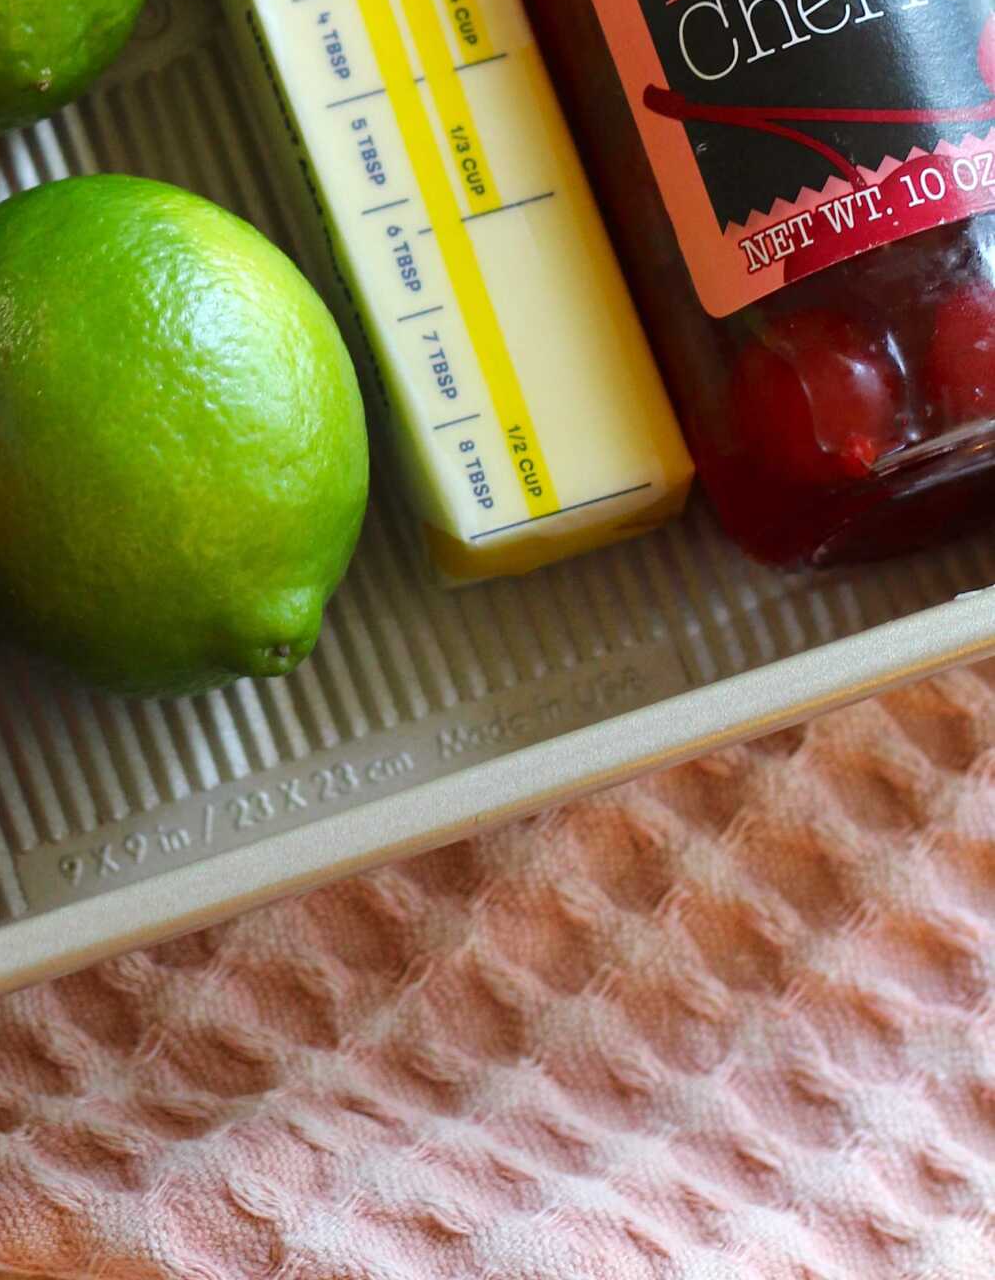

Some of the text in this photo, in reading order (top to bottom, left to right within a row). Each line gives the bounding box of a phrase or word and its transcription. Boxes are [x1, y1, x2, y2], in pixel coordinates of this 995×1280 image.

[317, 10, 351, 80] 4 TBSP
[454, 7, 478, 46] CUP
[351, 117, 386, 186] 5 TBSP
[450, 125, 486, 197] 1/3 CUP
[740, 212, 814, 273] NET
[818, 186, 894, 234] WT.
[900, 167, 946, 208] 10
[386, 225, 422, 293] 6 TBSP
[421, 331, 458, 400] 7 TBSP
[458, 439, 494, 509] 8 TBSP
[507, 424, 542, 498] 1/2 CUP
[58, 853, 83, 887] 9
[124, 831, 148, 865] 9
[158, 825, 192, 855] in
[227, 789, 276, 831] 23
[311, 760, 360, 802] 23
[366, 750, 415, 783] cm
